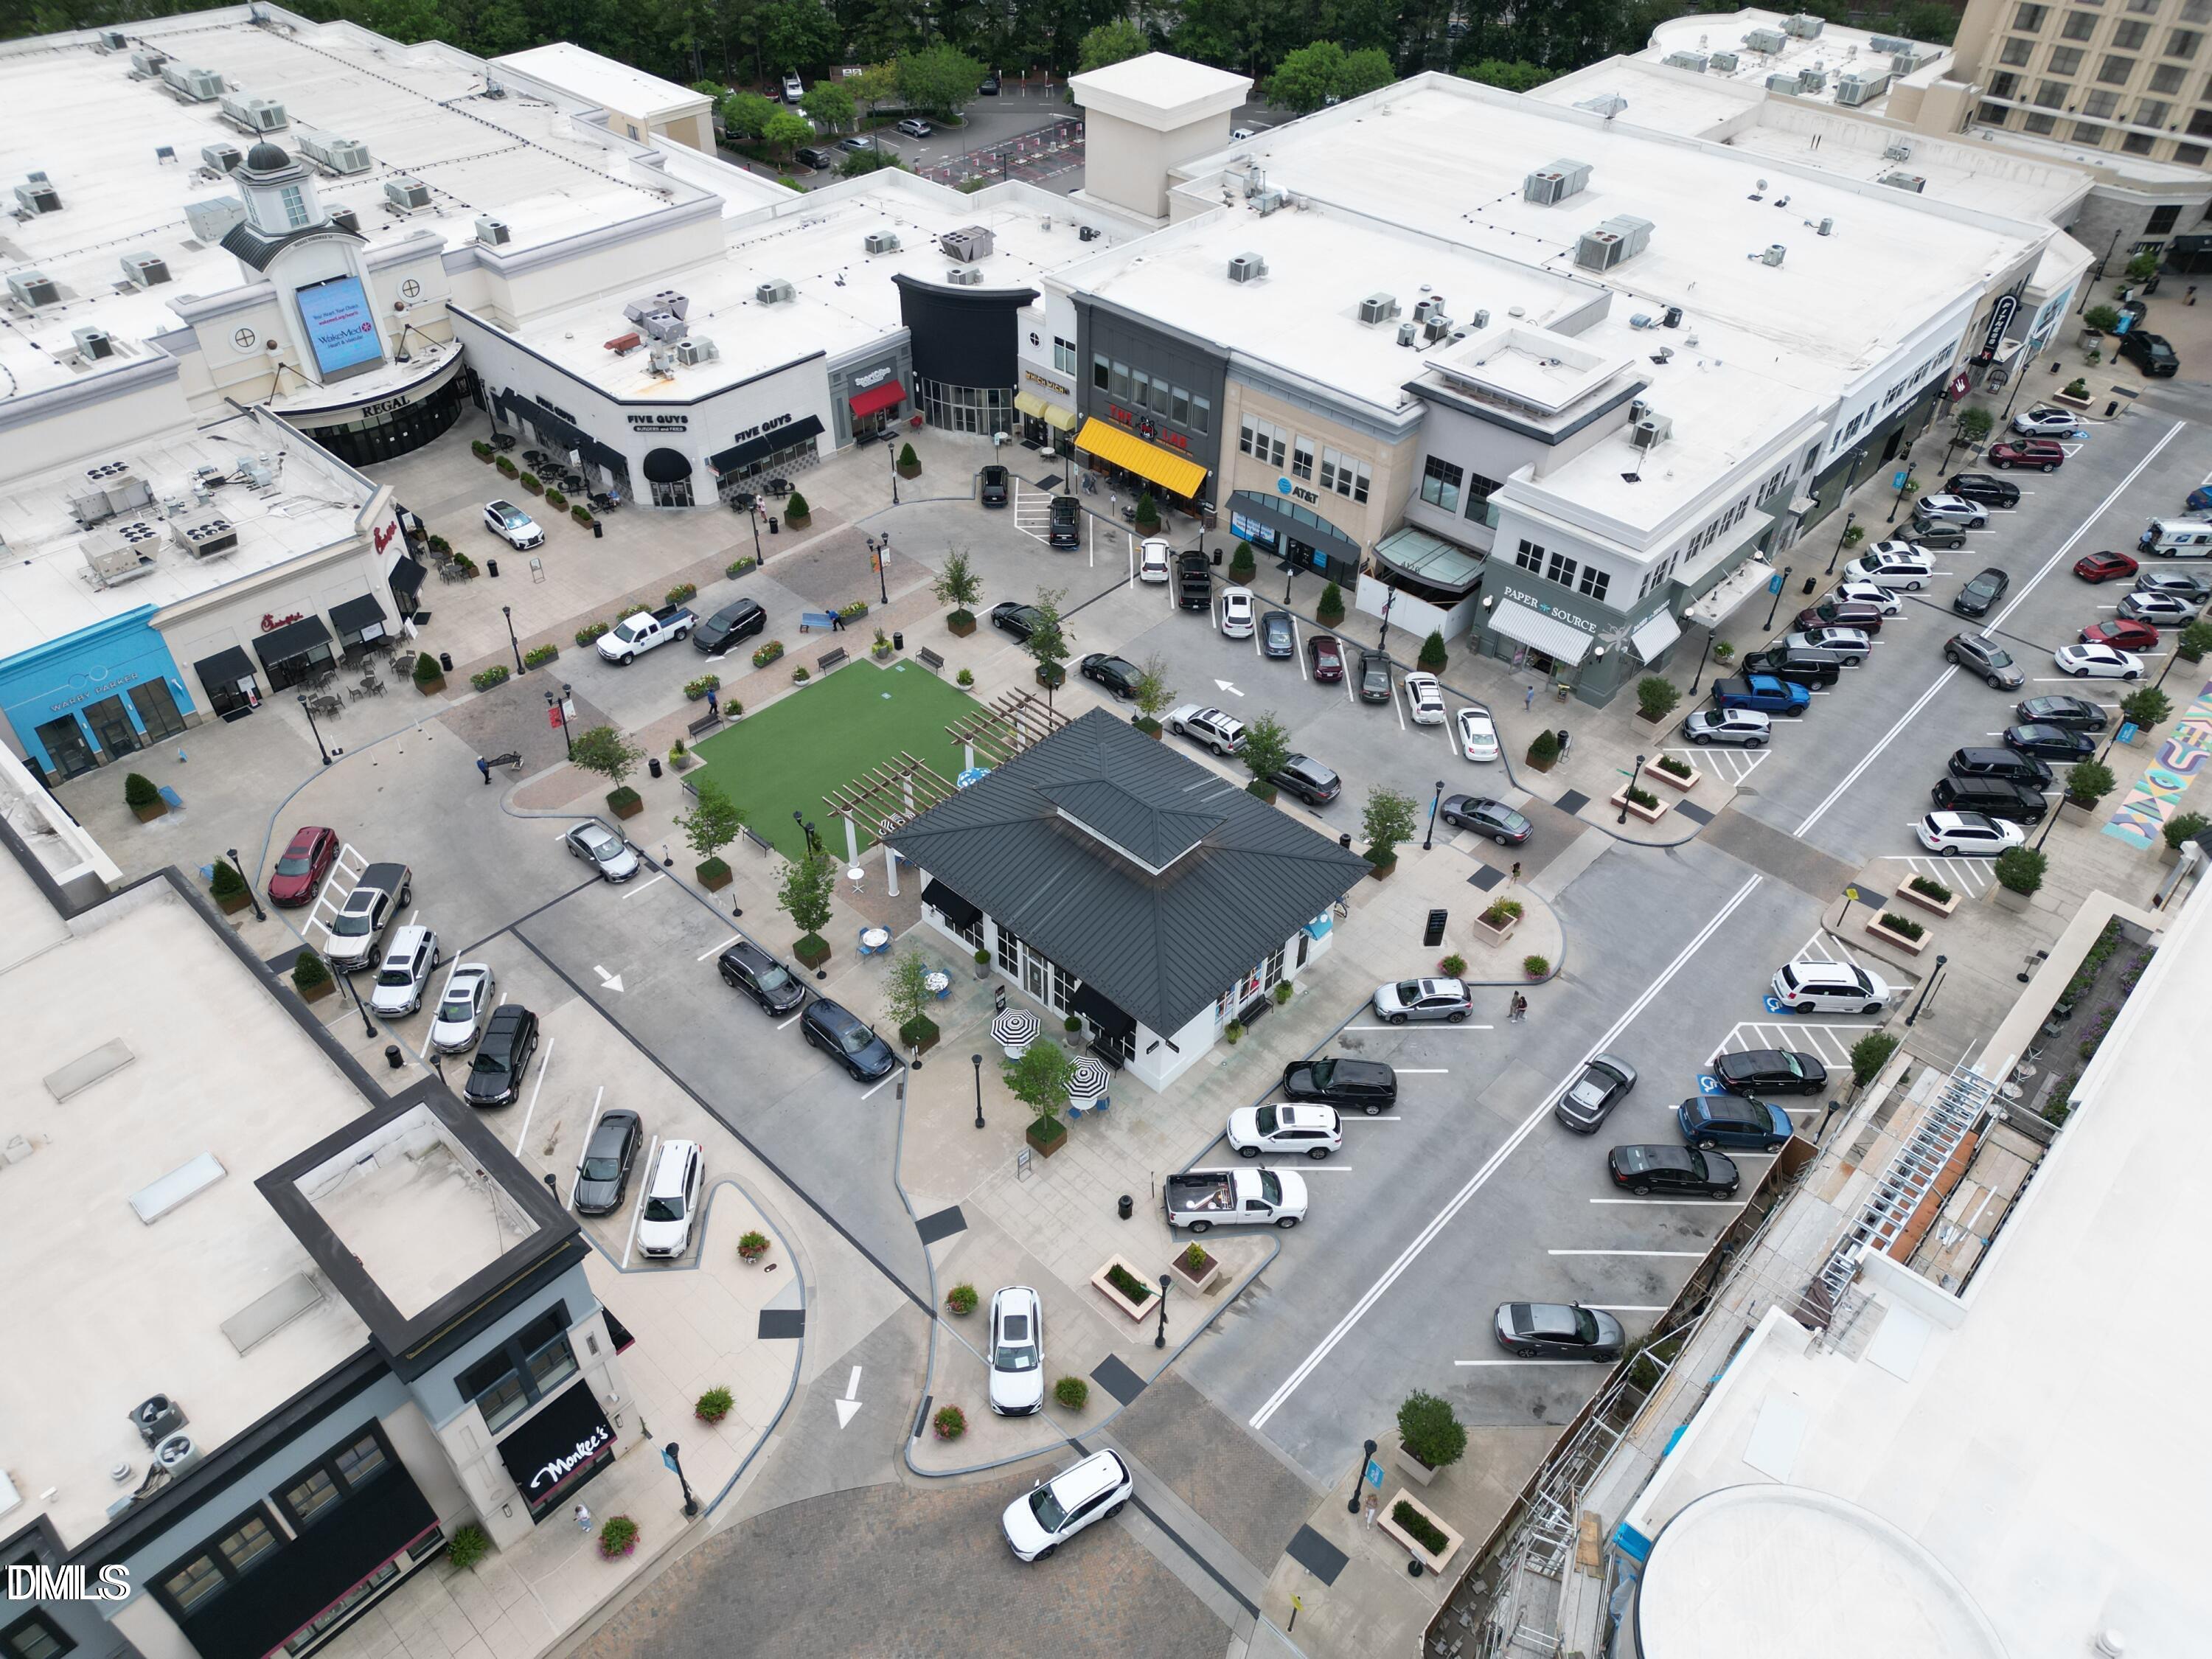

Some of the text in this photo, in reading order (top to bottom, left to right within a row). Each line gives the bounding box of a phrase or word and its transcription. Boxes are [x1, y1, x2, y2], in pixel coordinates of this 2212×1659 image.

[318, 325, 362, 344] WakeMed
[1988, 302, 2011, 344] FITNESS
[362, 395, 411, 417] REGAL
[627, 414, 689, 424] FIVE GUYS
[734, 413, 793, 444] FIVE GUYS
[1162, 426, 1188, 449] LAB
[1292, 486, 1319, 504] AT&T
[1504, 586, 1597, 633] PAPER SOURCE
[50, 672, 139, 712] WARBY PARKER
[530, 1426, 609, 1489] Monkee's
